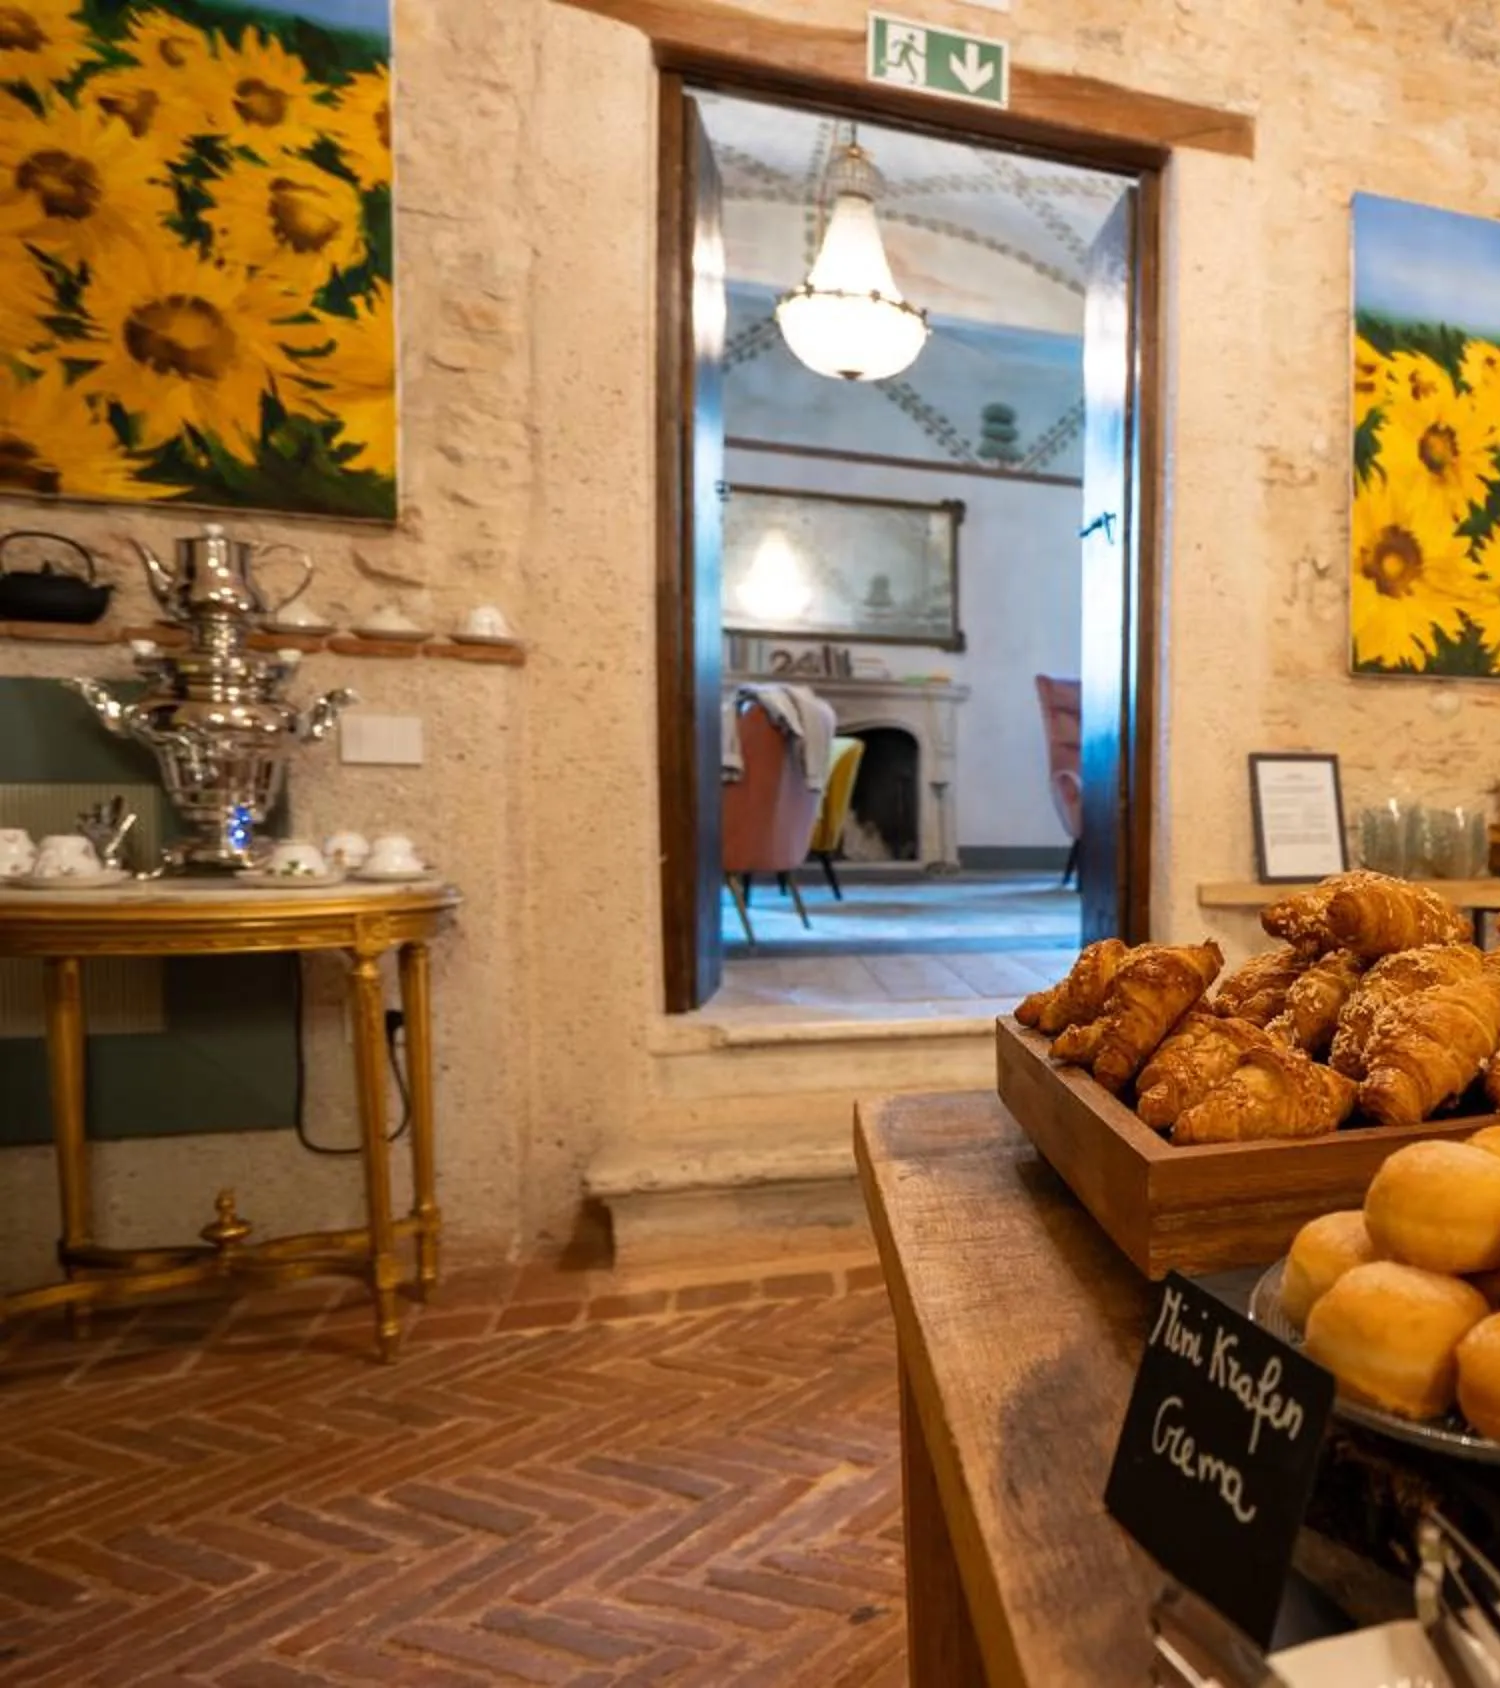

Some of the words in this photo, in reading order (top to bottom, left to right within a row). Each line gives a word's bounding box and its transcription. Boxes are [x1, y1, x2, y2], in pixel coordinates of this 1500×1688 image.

[1149, 1287, 1208, 1367] Mini
[1209, 1326, 1304, 1454] Krafen
[1151, 1396, 1256, 1524] Crema
